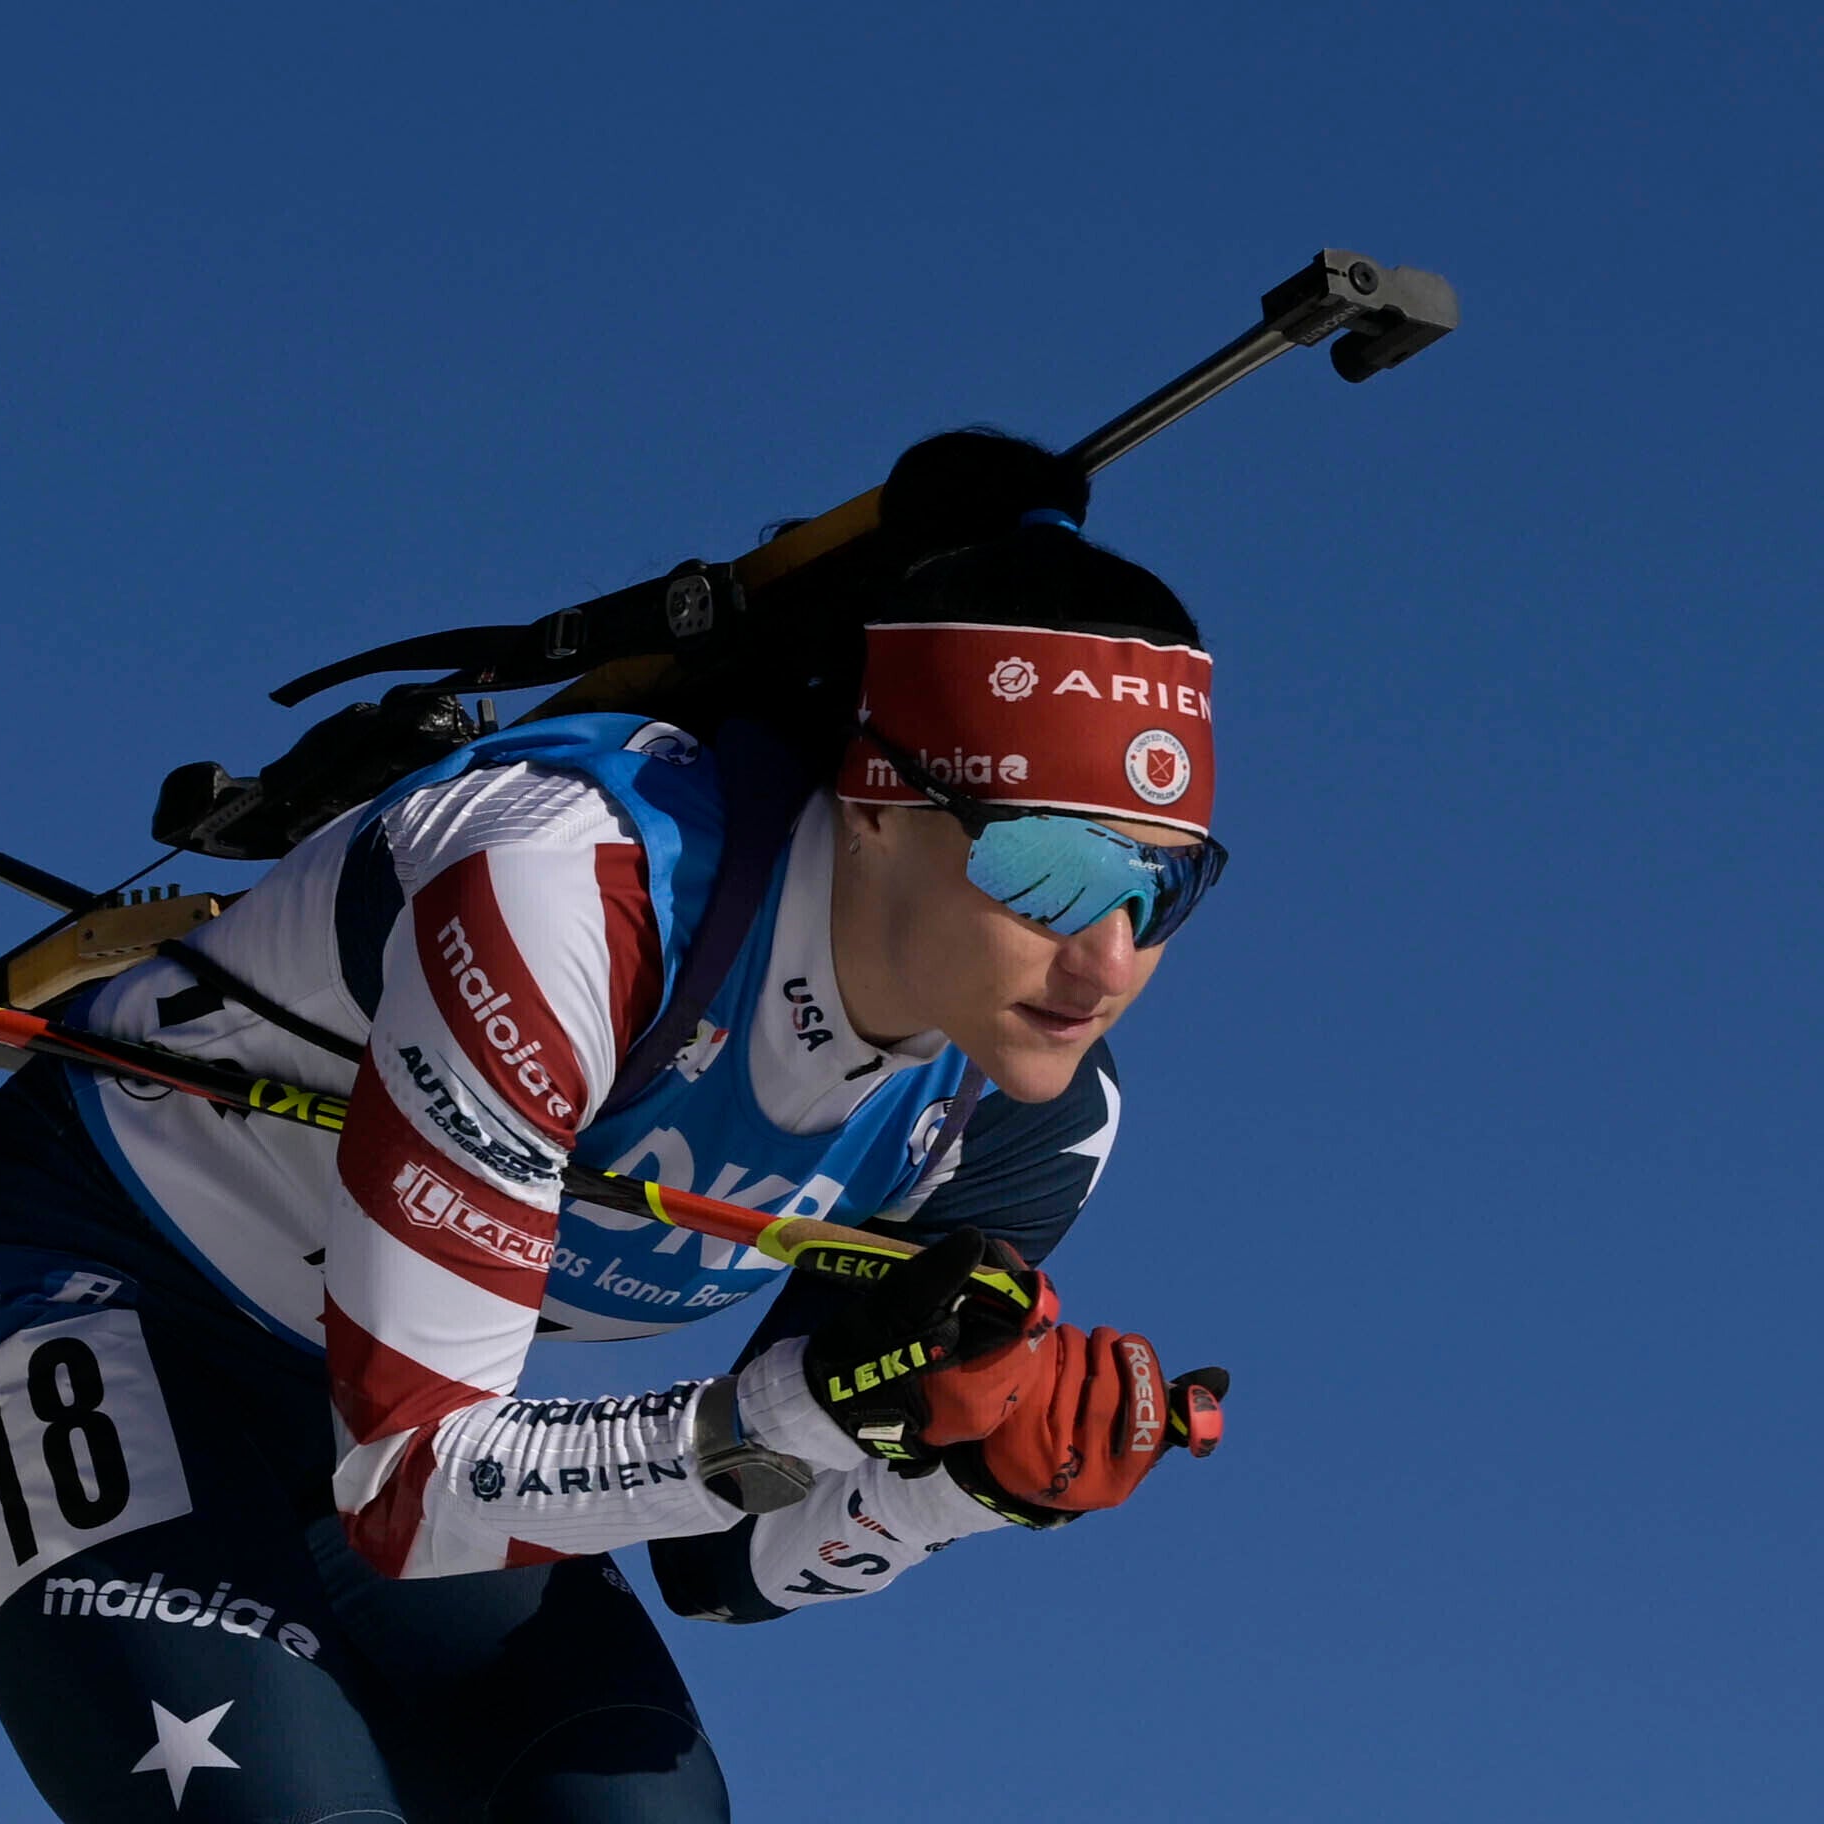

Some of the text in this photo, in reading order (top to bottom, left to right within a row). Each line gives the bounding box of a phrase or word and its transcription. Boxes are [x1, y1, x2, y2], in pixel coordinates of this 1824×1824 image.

[865, 746, 992, 787] mloja
[437, 915, 557, 1098] maloja
[783, 976, 834, 1053] USA
[550, 1230, 592, 1278] as
[593, 1257, 682, 1306] kann
[815, 1251, 892, 1280] LEKI
[828, 1341, 927, 1402] LEKI
[516, 1455, 688, 1497] ARIEN
[42, 1571, 276, 1639] maloja
